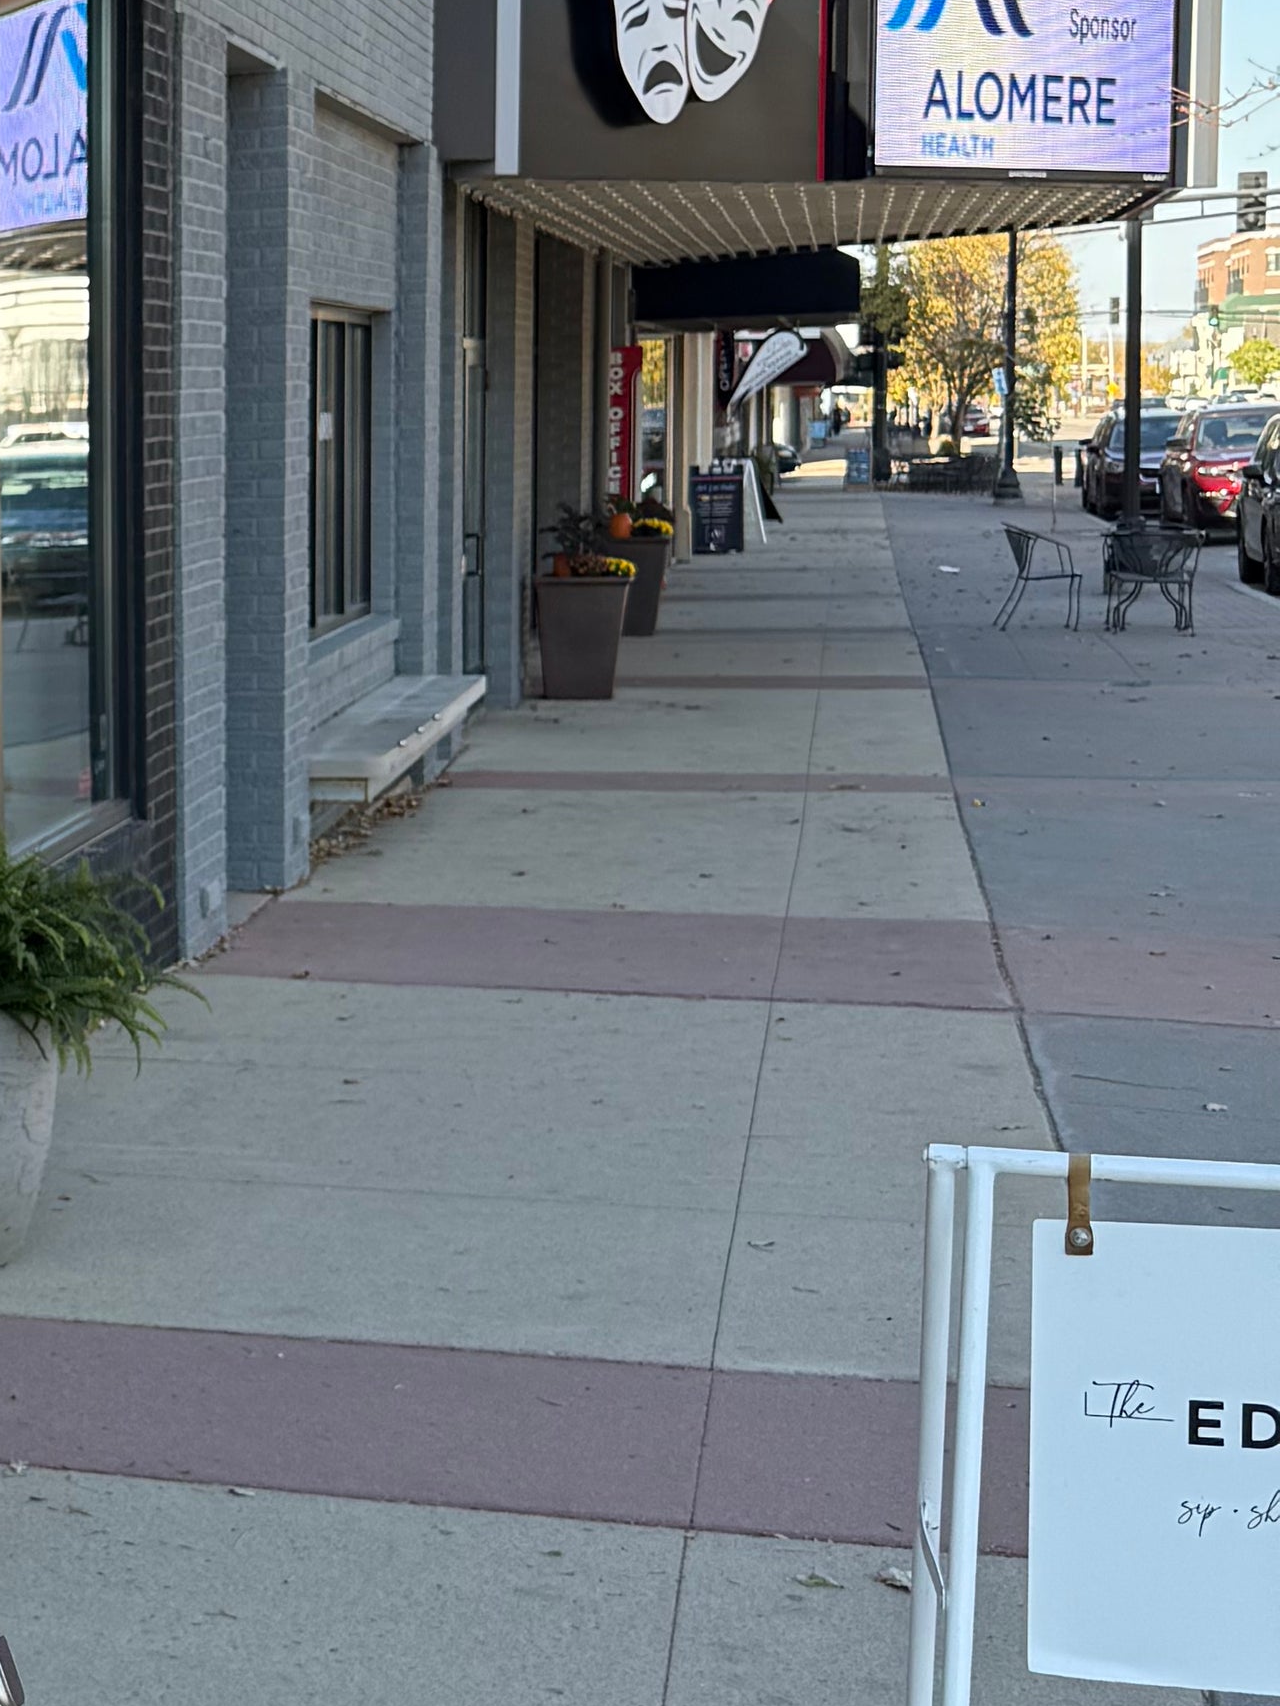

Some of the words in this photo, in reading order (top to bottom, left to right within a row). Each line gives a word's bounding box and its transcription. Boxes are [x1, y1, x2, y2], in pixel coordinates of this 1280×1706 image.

[1069, 8, 1137, 44] Sponsor
[922, 68, 1118, 126] ALOMERE
[921, 134, 995, 158] HEALTH
[609, 351, 624, 396] BOX
[1092, 1379, 1156, 1428] The
[1188, 1399, 1280, 1450] ED
[1177, 1497, 1222, 1537] sip
